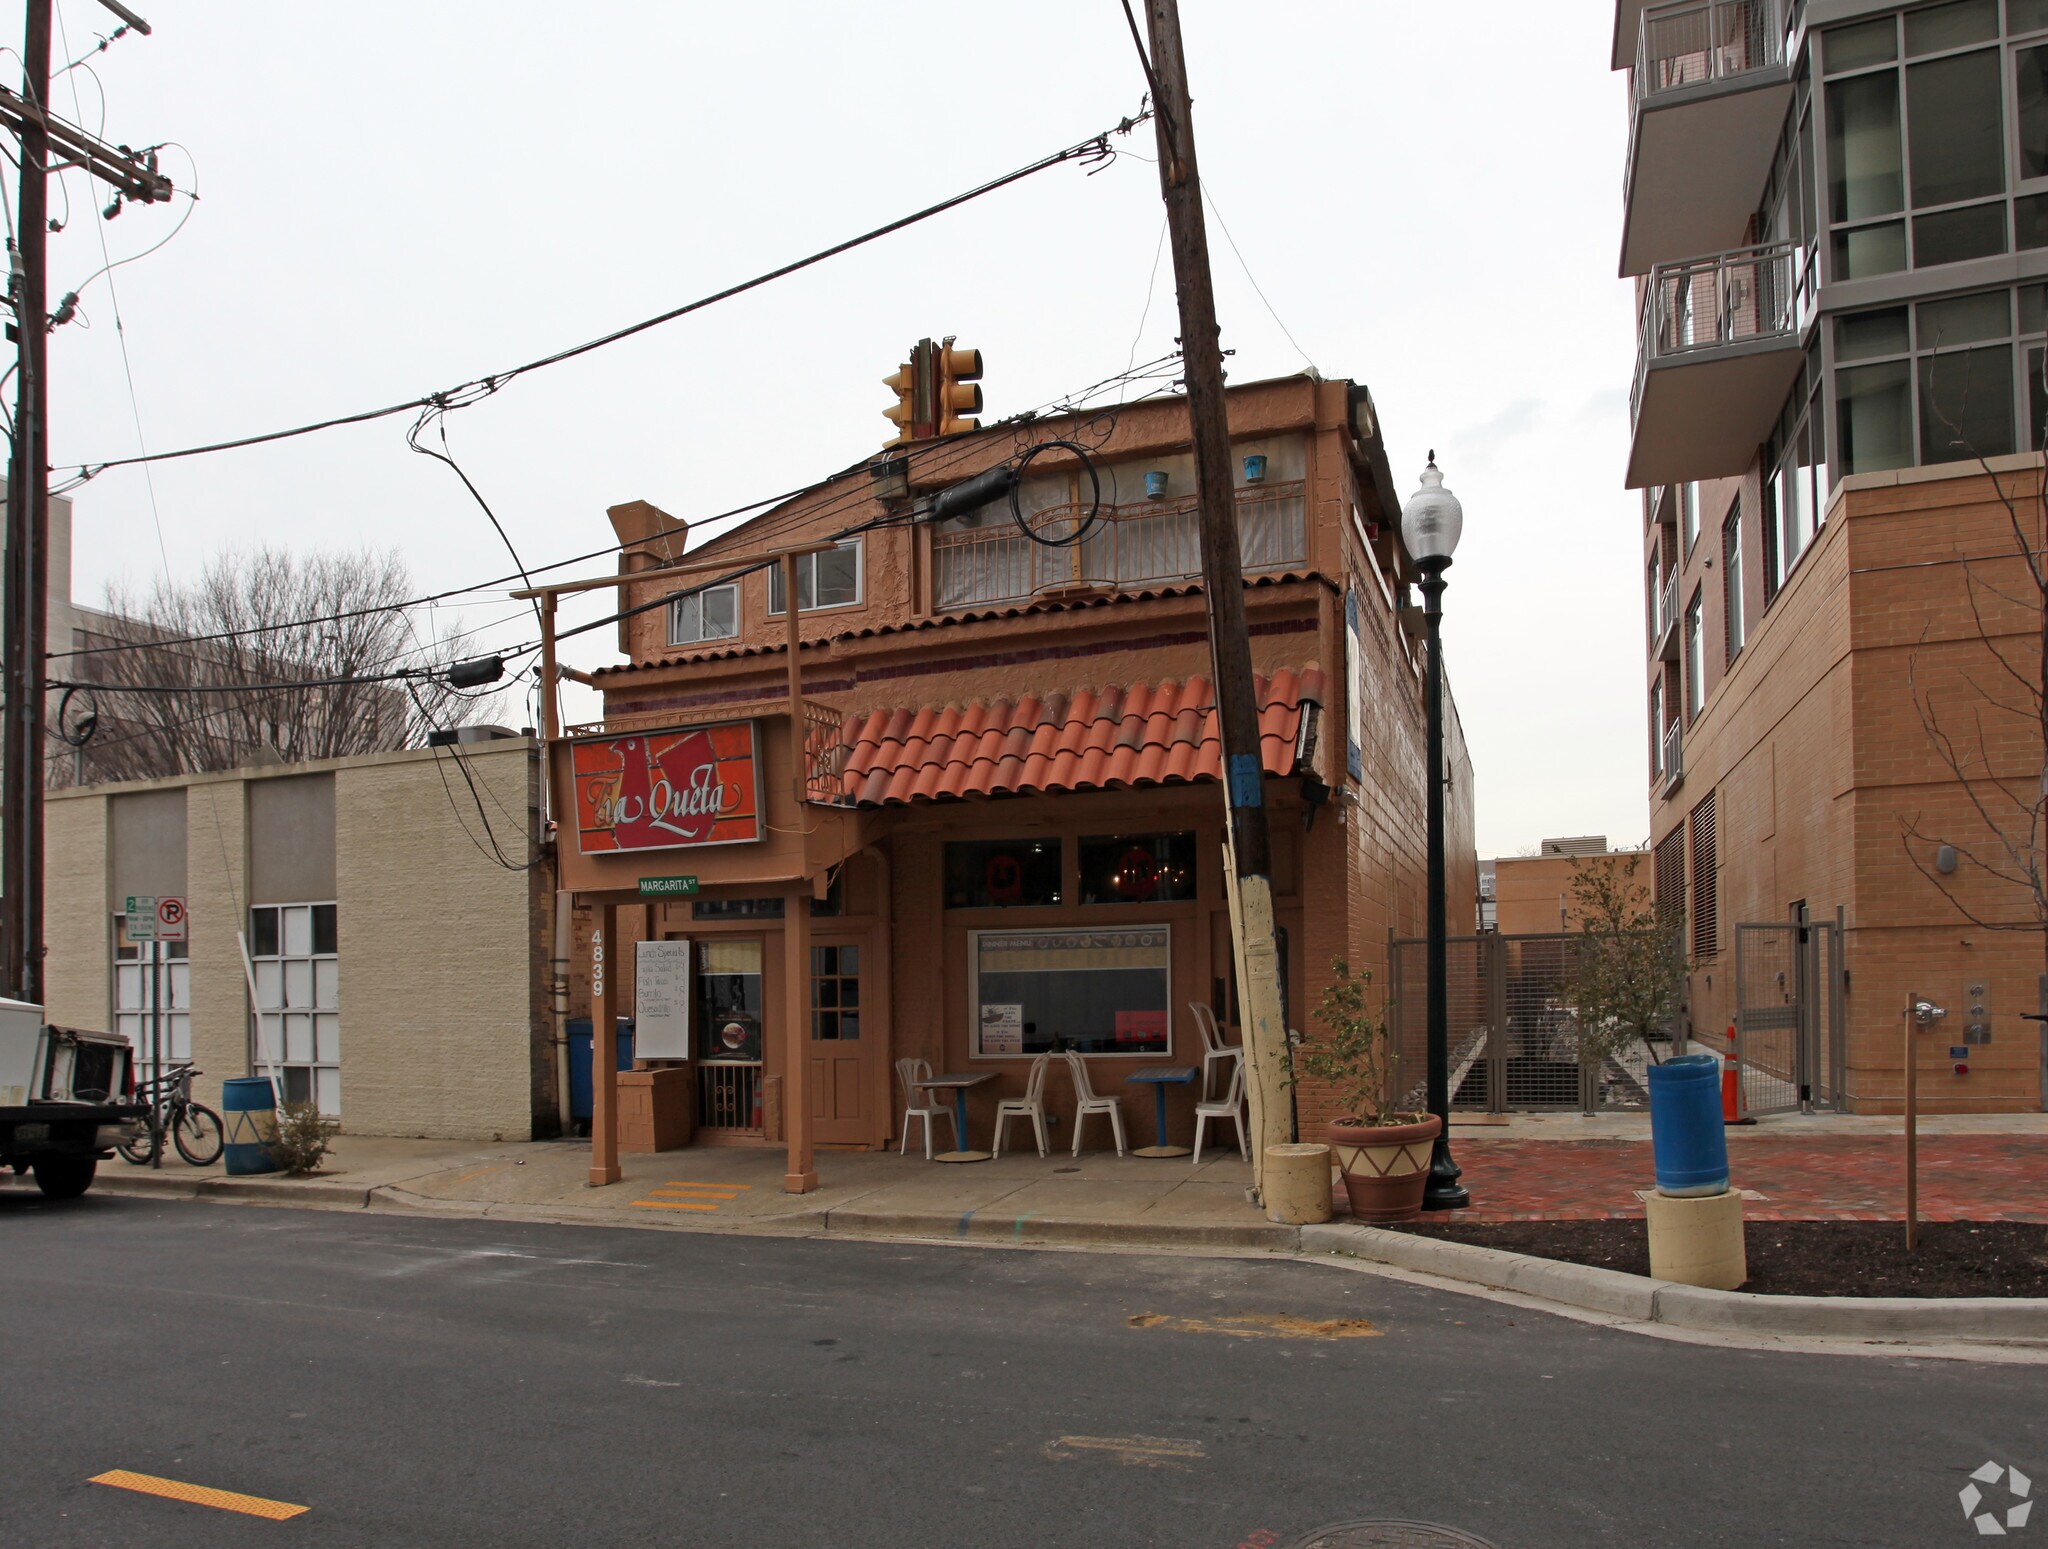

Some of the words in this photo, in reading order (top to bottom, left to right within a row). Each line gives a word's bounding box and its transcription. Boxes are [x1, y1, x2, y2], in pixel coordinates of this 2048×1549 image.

[649, 763, 743, 838] Queta
[641, 880, 689, 893] MARGARITA
[128, 899, 135, 911] 2
[1009, 939, 1032, 947] MENU
[591, 929, 603, 997] 4839
